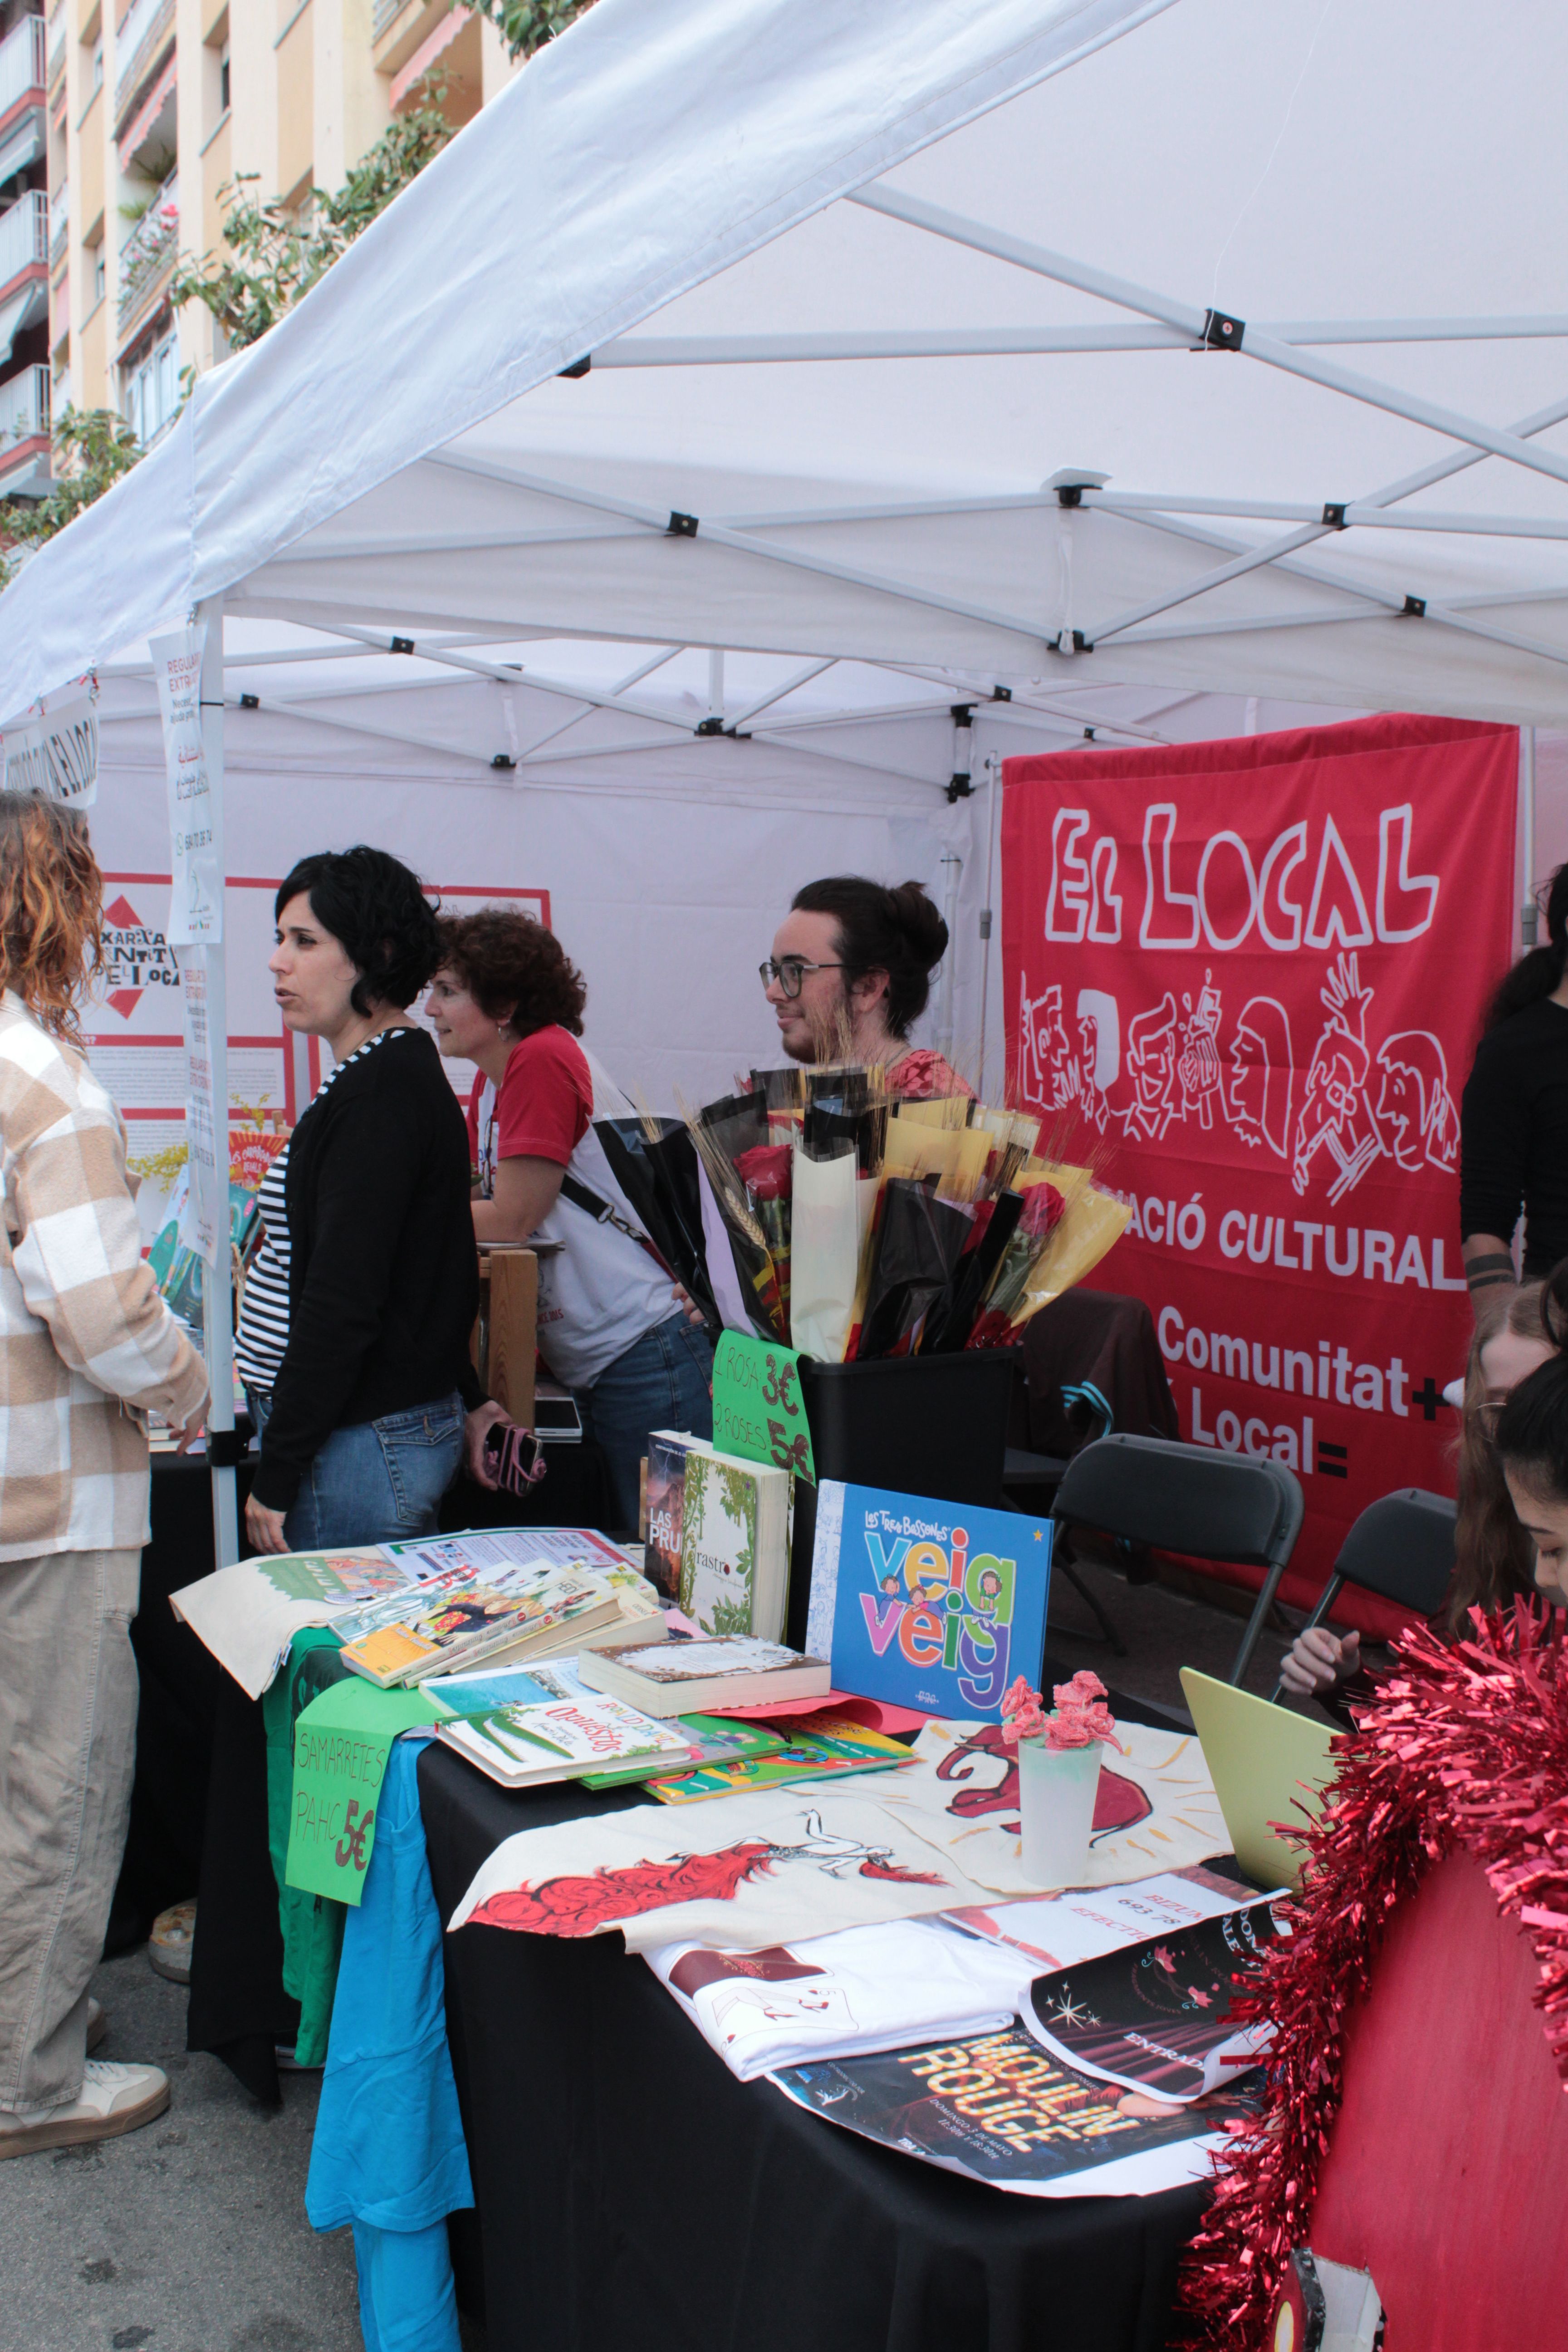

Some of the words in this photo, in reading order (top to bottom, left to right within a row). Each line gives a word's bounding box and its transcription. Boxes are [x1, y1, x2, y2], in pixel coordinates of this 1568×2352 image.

[1140, 803, 1439, 950] LOCAL
[101, 929, 166, 946] XARXA
[1219, 1210, 1467, 1291] CULTURAL
[762, 1354, 799, 1416] 3€
[766, 1418, 814, 1482] 5€
[650, 1507, 672, 1529] LAS
[650, 1524, 680, 1554] PRU
[864, 1527, 1016, 1648] veig
[859, 1590, 1011, 1710] veig
[545, 1707, 624, 1753] Opuestos
[596, 1702, 644, 1725] ROALD
[631, 1723, 670, 1744] DAHL
[298, 1733, 386, 1788] SAMARRETES
[335, 1799, 375, 1871] 5€
[1118, 1899, 1153, 1914] 693
[1123, 2032, 1205, 2070] ENTRAD
[897, 2046, 1082, 2153] ROUGE
[960, 2033, 1141, 2137] MOULIN
[930, 2098, 970, 2127] DOMINGO
[976, 2132, 986, 2141] DE
[984, 2137, 1013, 2156] MAYO
